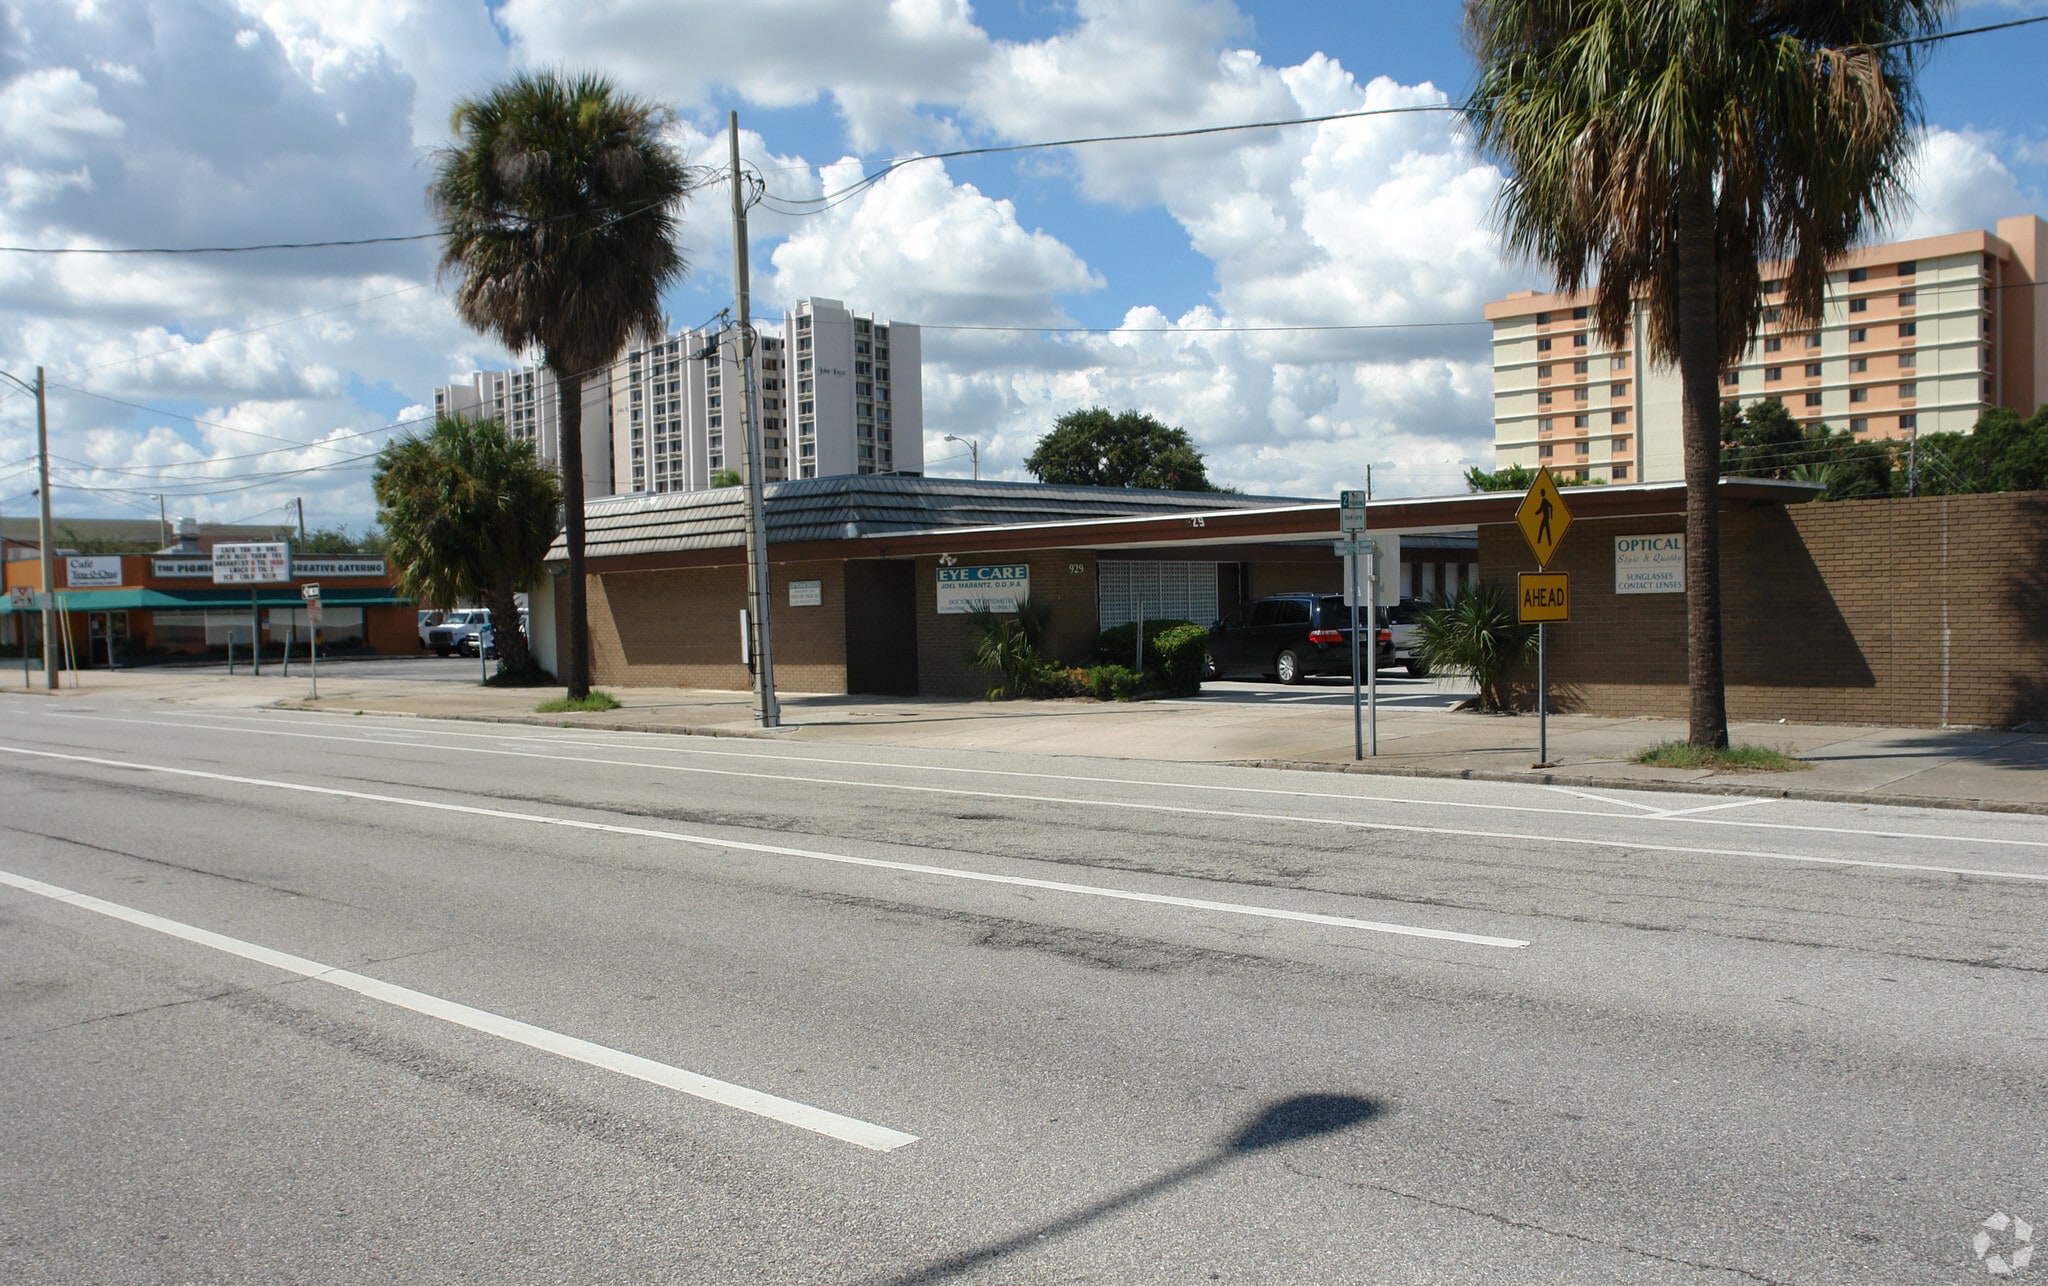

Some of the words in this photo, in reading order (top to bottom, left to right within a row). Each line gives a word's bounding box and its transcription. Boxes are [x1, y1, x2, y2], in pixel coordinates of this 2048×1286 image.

[1343, 494, 1348, 506] 2
[1617, 538, 1681, 552] OPTICAL
[1617, 554, 1639, 565] Style
[1653, 553, 1682, 563] Quality
[940, 569, 969, 580] EYE
[977, 567, 1025, 580] CARE
[1068, 563, 1084, 574] 929
[1626, 572, 1673, 581] SUNGLASSES
[1618, 582, 1653, 590] CONTACT
[1655, 580, 1682, 589] LENSES
[1523, 587, 1565, 608] AHEAD
